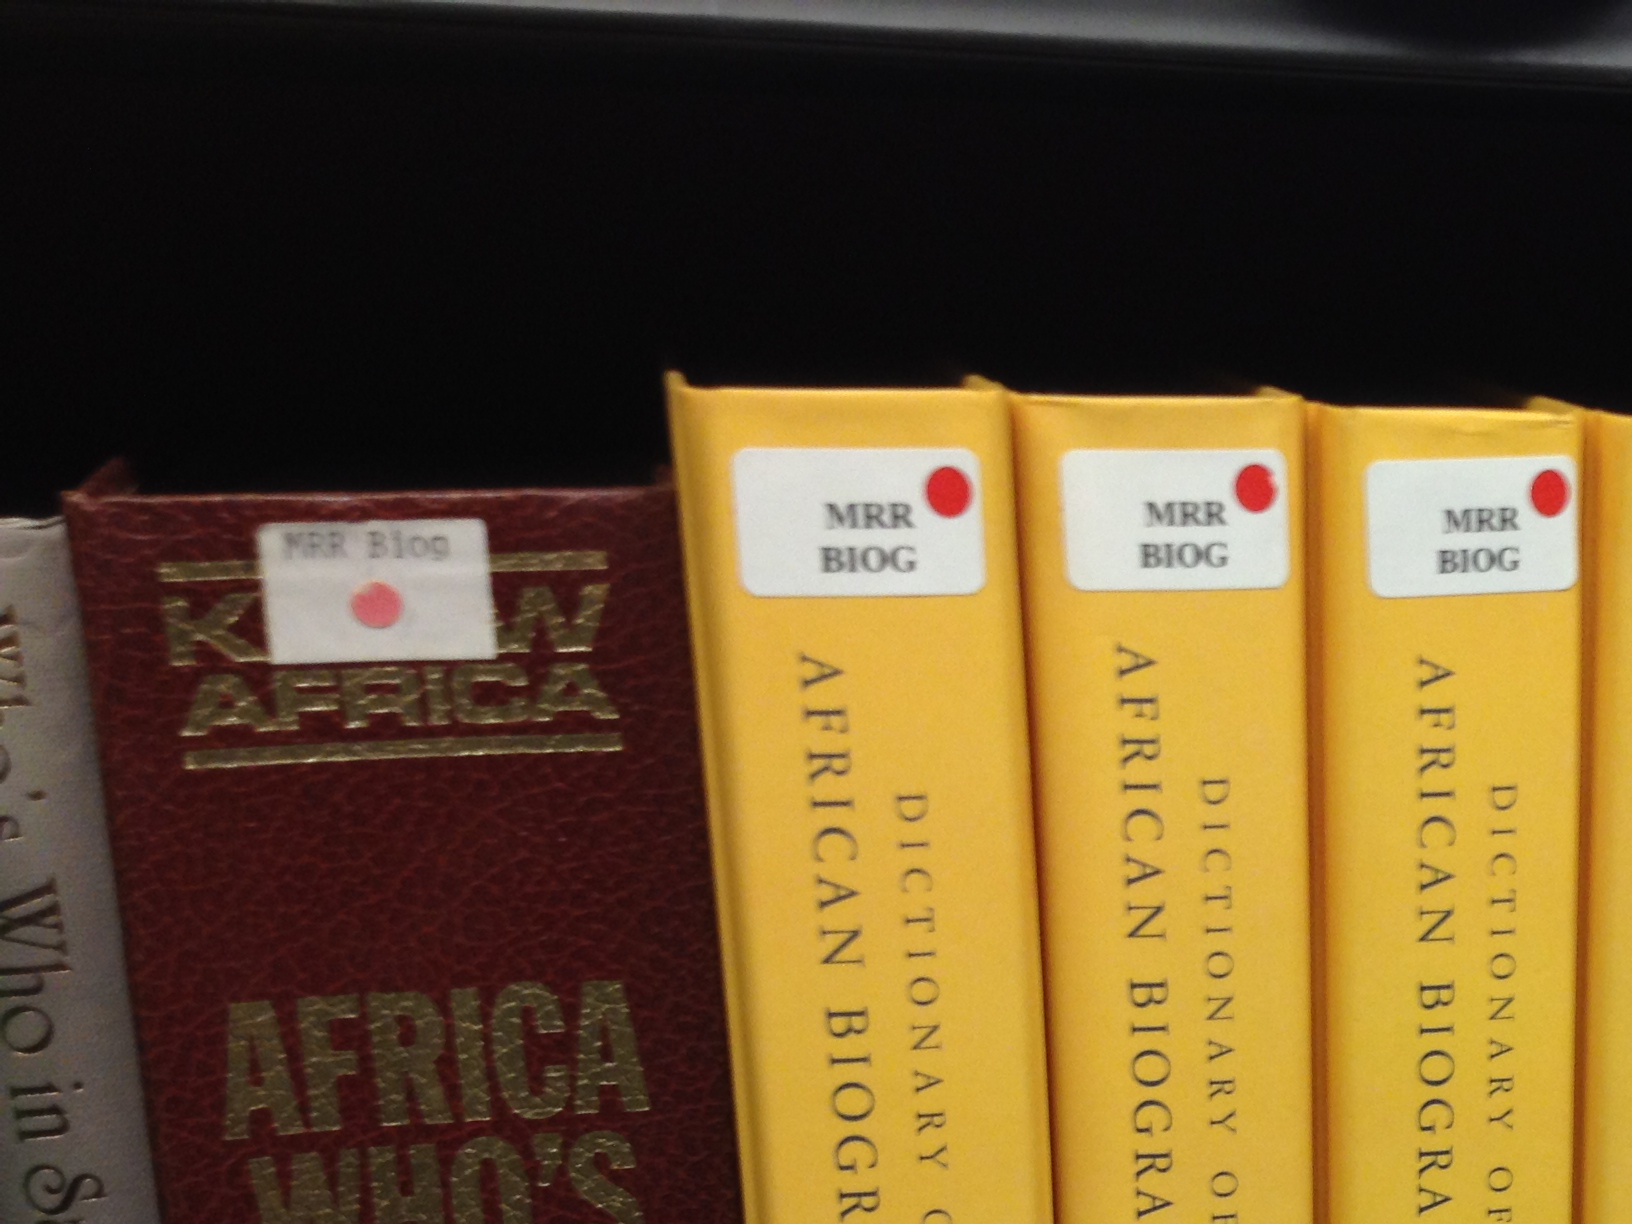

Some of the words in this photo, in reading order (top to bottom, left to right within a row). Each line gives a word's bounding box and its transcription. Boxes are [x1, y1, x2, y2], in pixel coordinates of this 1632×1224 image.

[824, 502, 916, 529] MRR
[1143, 500, 1228, 527] MRR
[1442, 507, 1520, 533] MRR
[282, 532, 345, 559] MRR
[818, 546, 918, 574] BIOG
[1138, 542, 1230, 569] BIOG
[1437, 547, 1520, 574] BIOG
[180, 662, 621, 736] AFRICA
[799, 651, 866, 967] AFRICAN
[1115, 642, 1166, 942] AFRICAN
[1416, 656, 1457, 945] AFRICAN
[896, 792, 950, 1171] DICTIONARY
[1199, 777, 1238, 1134] DICTIONARY
[1487, 783, 1518, 1131] DICTIONARY
[222, 981, 652, 1141] AFRICA
[10, 1081, 83, 1142] in
[1488, 1165, 1514, 1224] OF
